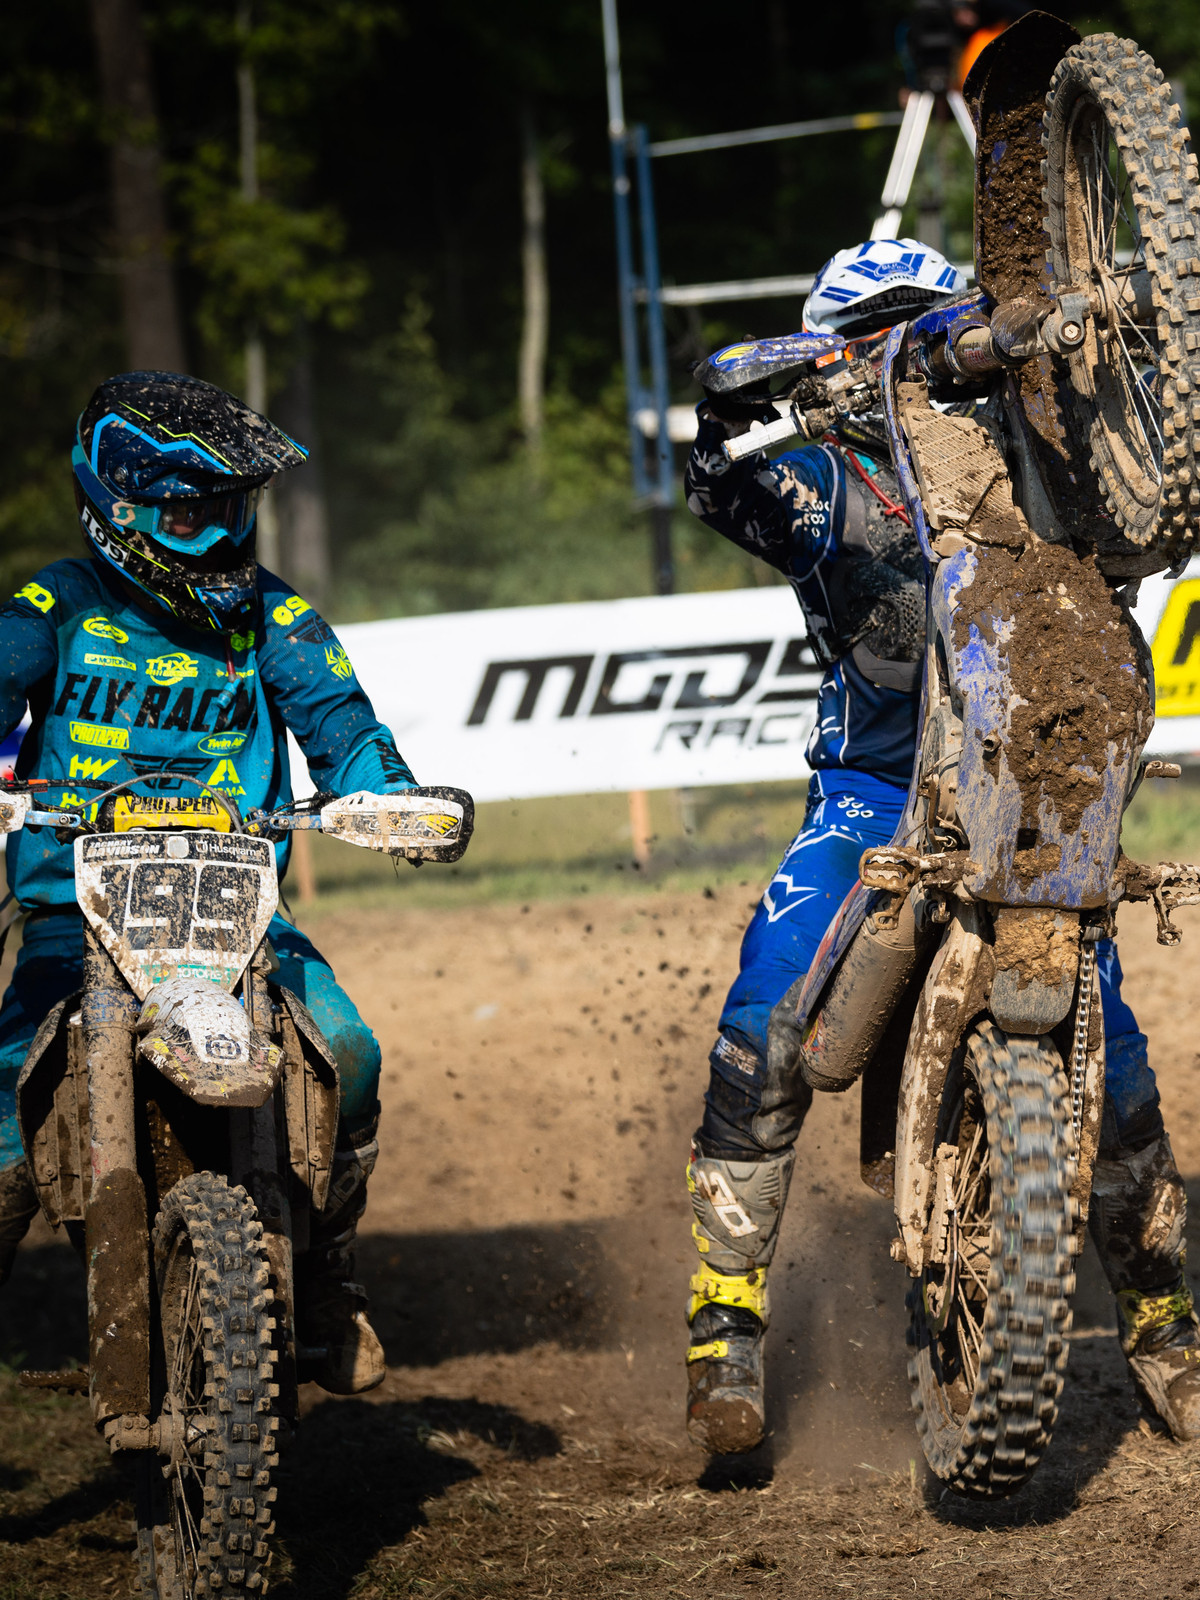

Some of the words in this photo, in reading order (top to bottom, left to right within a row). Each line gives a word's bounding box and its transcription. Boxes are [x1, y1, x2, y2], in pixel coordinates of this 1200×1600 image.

[84, 509, 124, 563] 199
[54, 672, 136, 723] FLY
[133, 684, 258, 733] RACIN
[466, 637, 823, 726] MOOS
[72, 724, 128, 747] PROTAPER
[100, 862, 261, 954] 199
